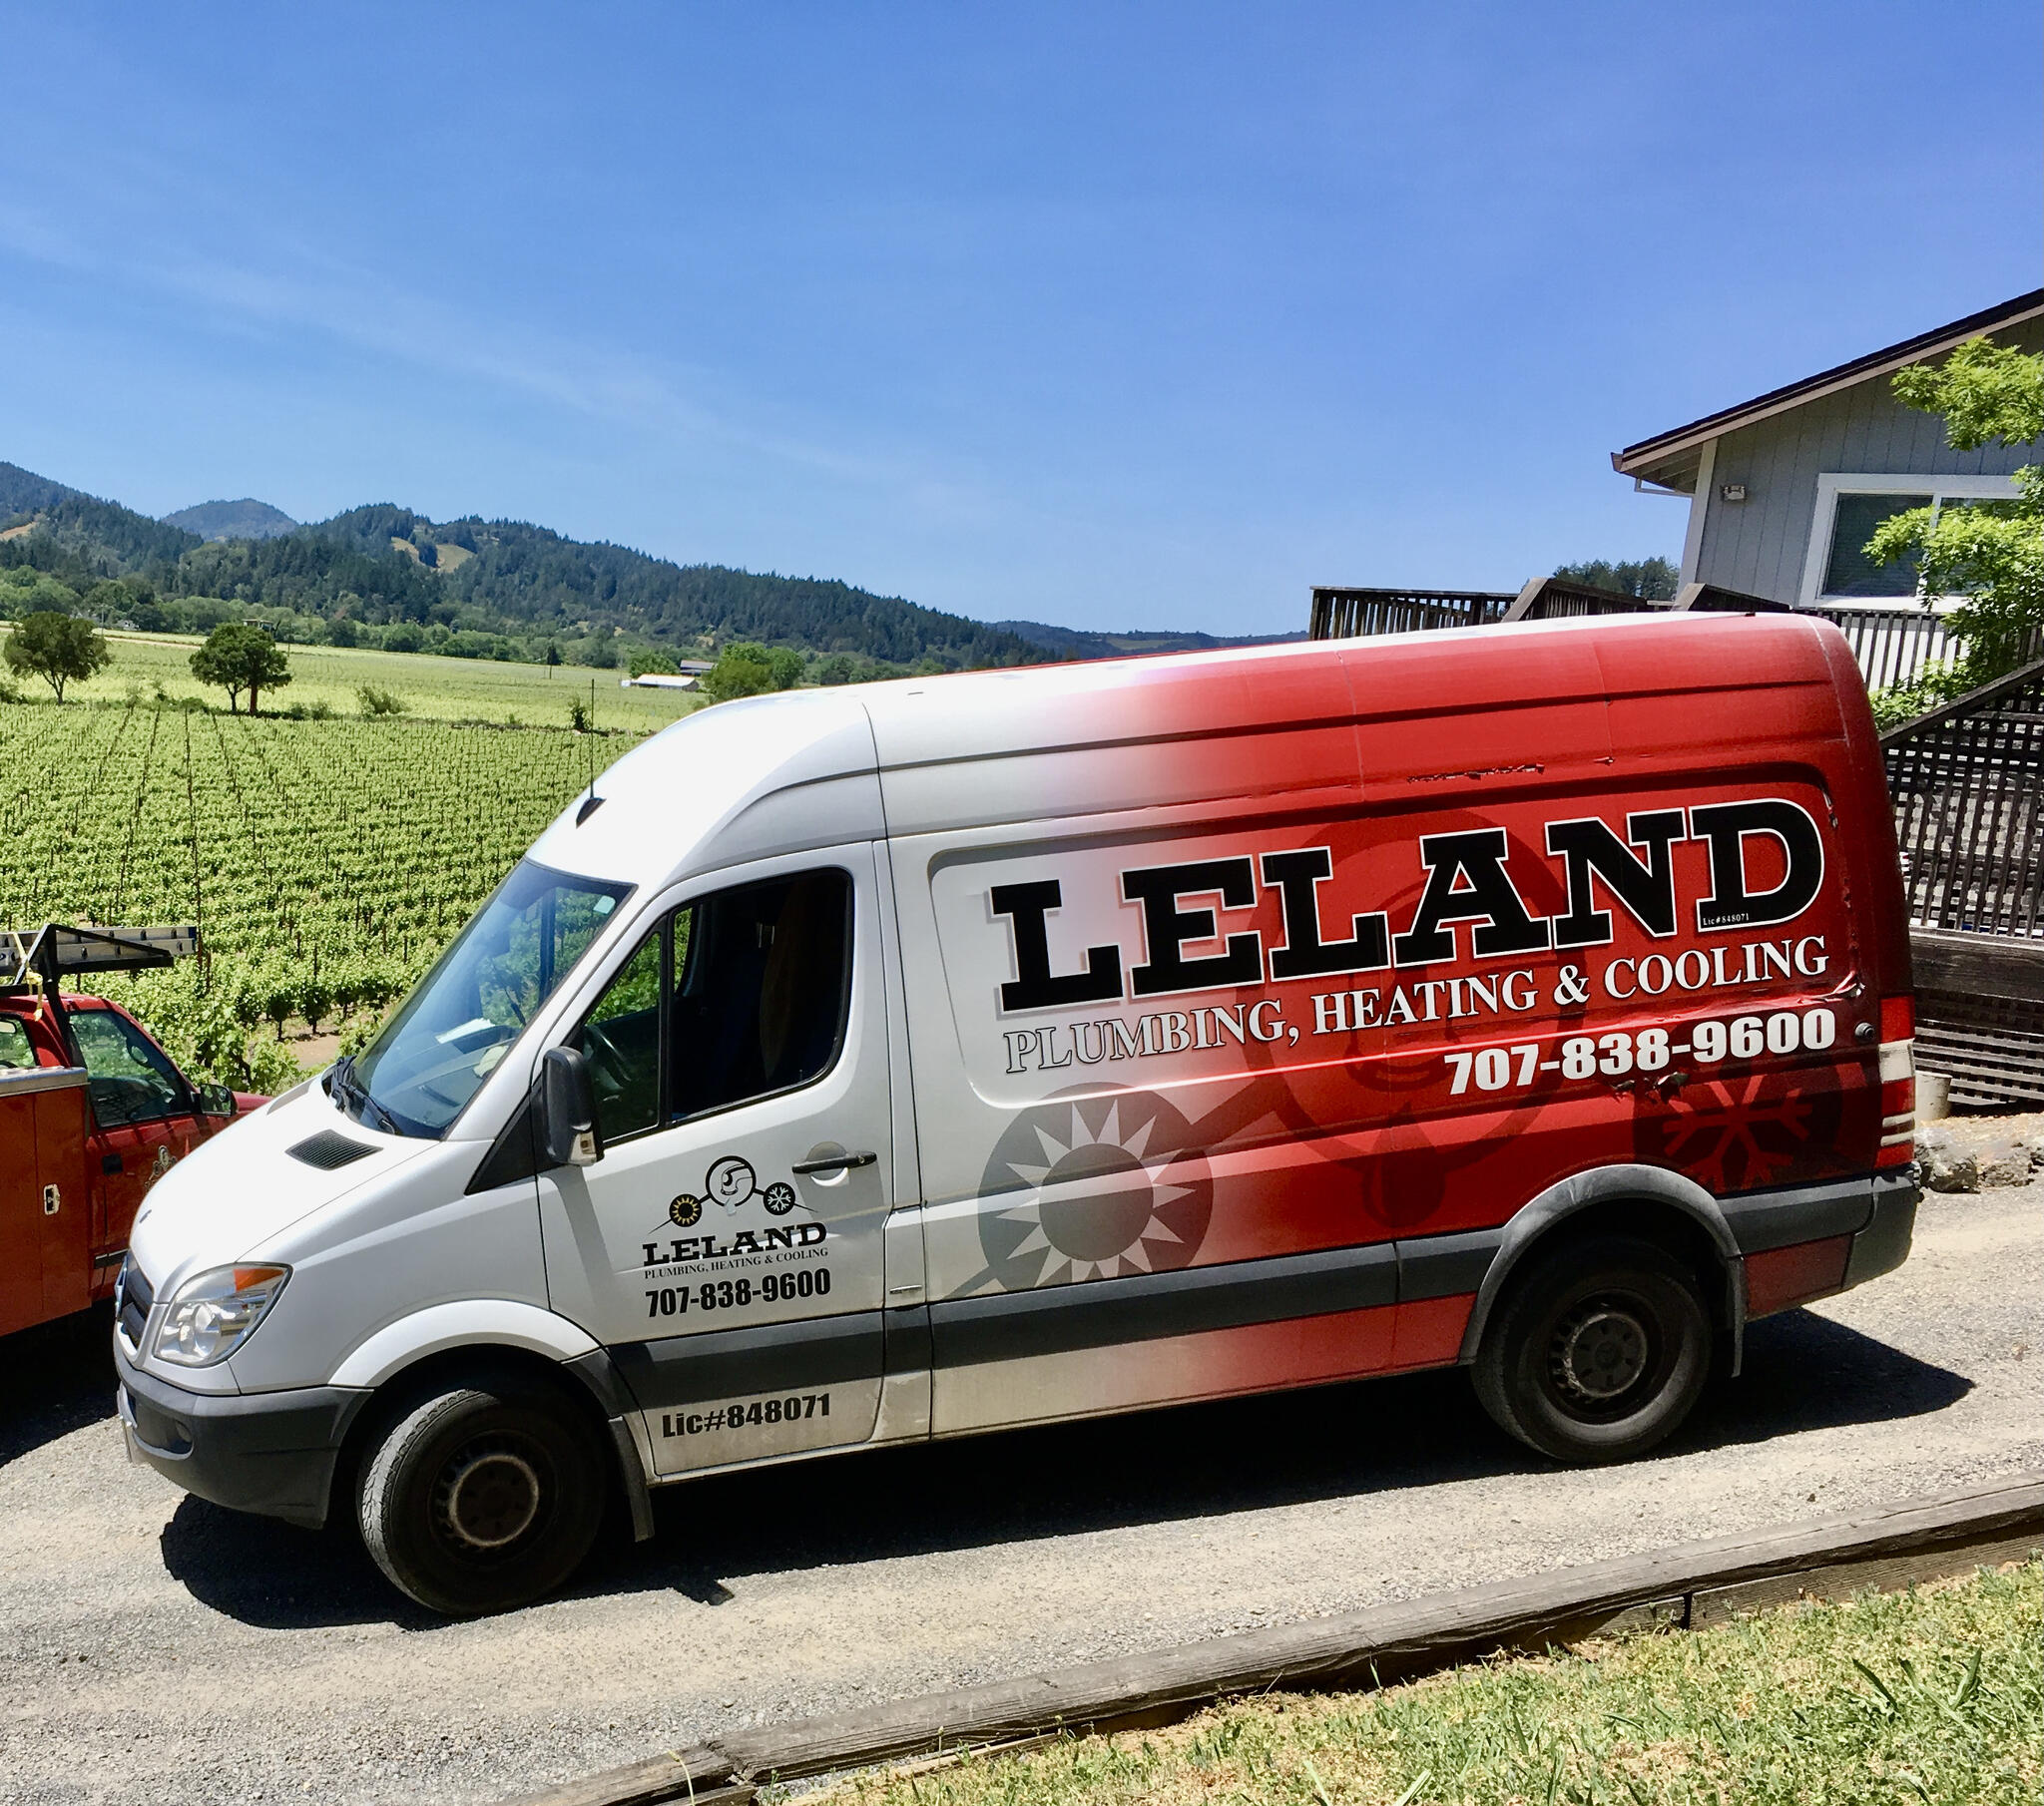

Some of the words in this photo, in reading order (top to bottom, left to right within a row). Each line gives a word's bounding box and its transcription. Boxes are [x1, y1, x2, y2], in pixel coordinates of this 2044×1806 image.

[991, 798, 1825, 1015] LELAND
[1004, 999, 1299, 1075] PLUMBING,
[1310, 968, 1539, 1037] HEATING
[1553, 964, 1590, 1006] &
[1604, 935, 1829, 1000] COOLING
[1444, 1008, 1835, 1095] 707-838-9600
[642, 1221, 826, 1266] LELAND
[711, 1255, 762, 1270] HEATING
[764, 1254, 773, 1264] &
[775, 1247, 828, 1264] COOLING
[645, 1268, 830, 1317] 707-838-9600
[662, 1393, 829, 1438] Lic#848071
